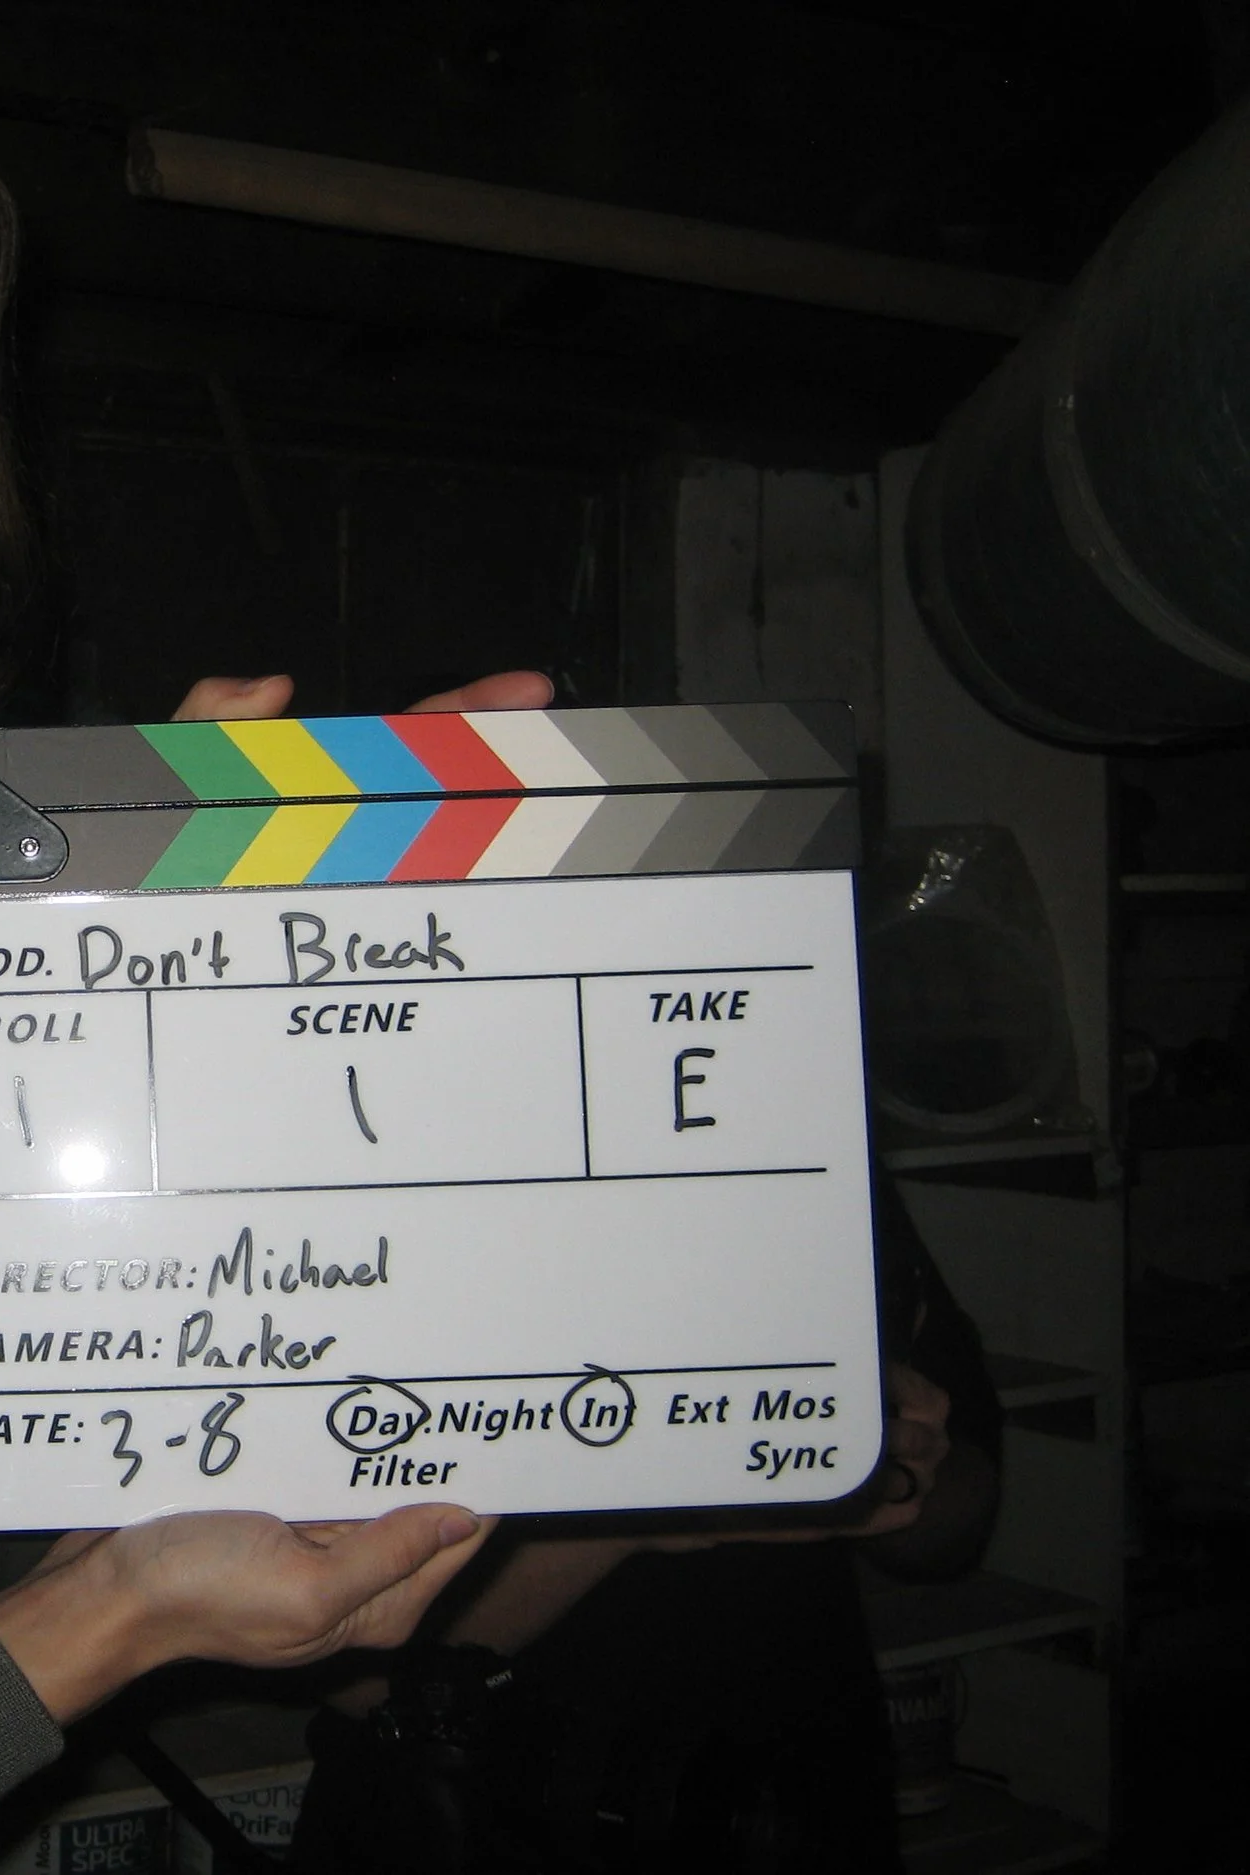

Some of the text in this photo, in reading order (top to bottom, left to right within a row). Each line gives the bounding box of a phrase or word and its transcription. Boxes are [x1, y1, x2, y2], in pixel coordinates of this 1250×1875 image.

[77, 912, 466, 990] Don't Break
[286, 1002, 418, 1036] SCENE
[650, 991, 750, 1022] TAKE
[673, 1047, 716, 1133] E
[207, 1226, 389, 1300] Michael
[176, 1309, 338, 1372] Parker
[666, 1394, 730, 1425] Ext
[752, 1389, 837, 1422] Mos
[348, 1442, 840, 1488] Filter Sync
[71, 1815, 146, 1848] ULTRA
[71, 1843, 137, 1874] SPEC
